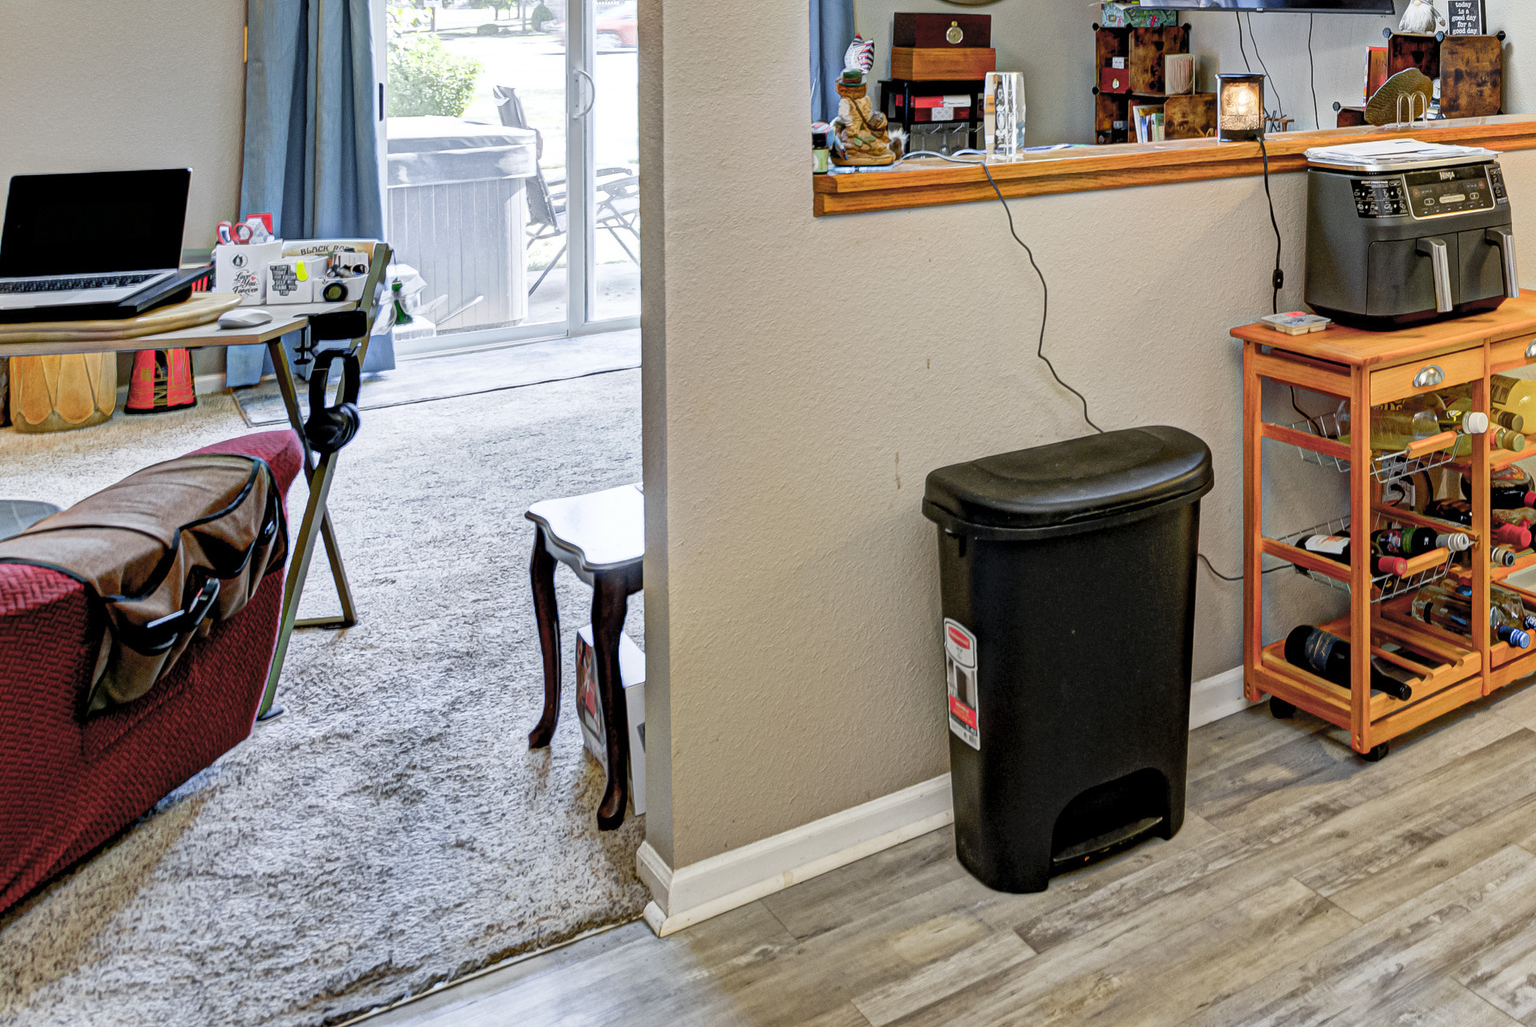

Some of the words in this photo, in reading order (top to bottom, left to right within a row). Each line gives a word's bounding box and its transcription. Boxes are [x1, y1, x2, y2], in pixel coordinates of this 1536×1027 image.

[1451, 15, 1465, 23] good
[1452, 28, 1466, 36] good
[300, 244, 329, 256] BLACK
